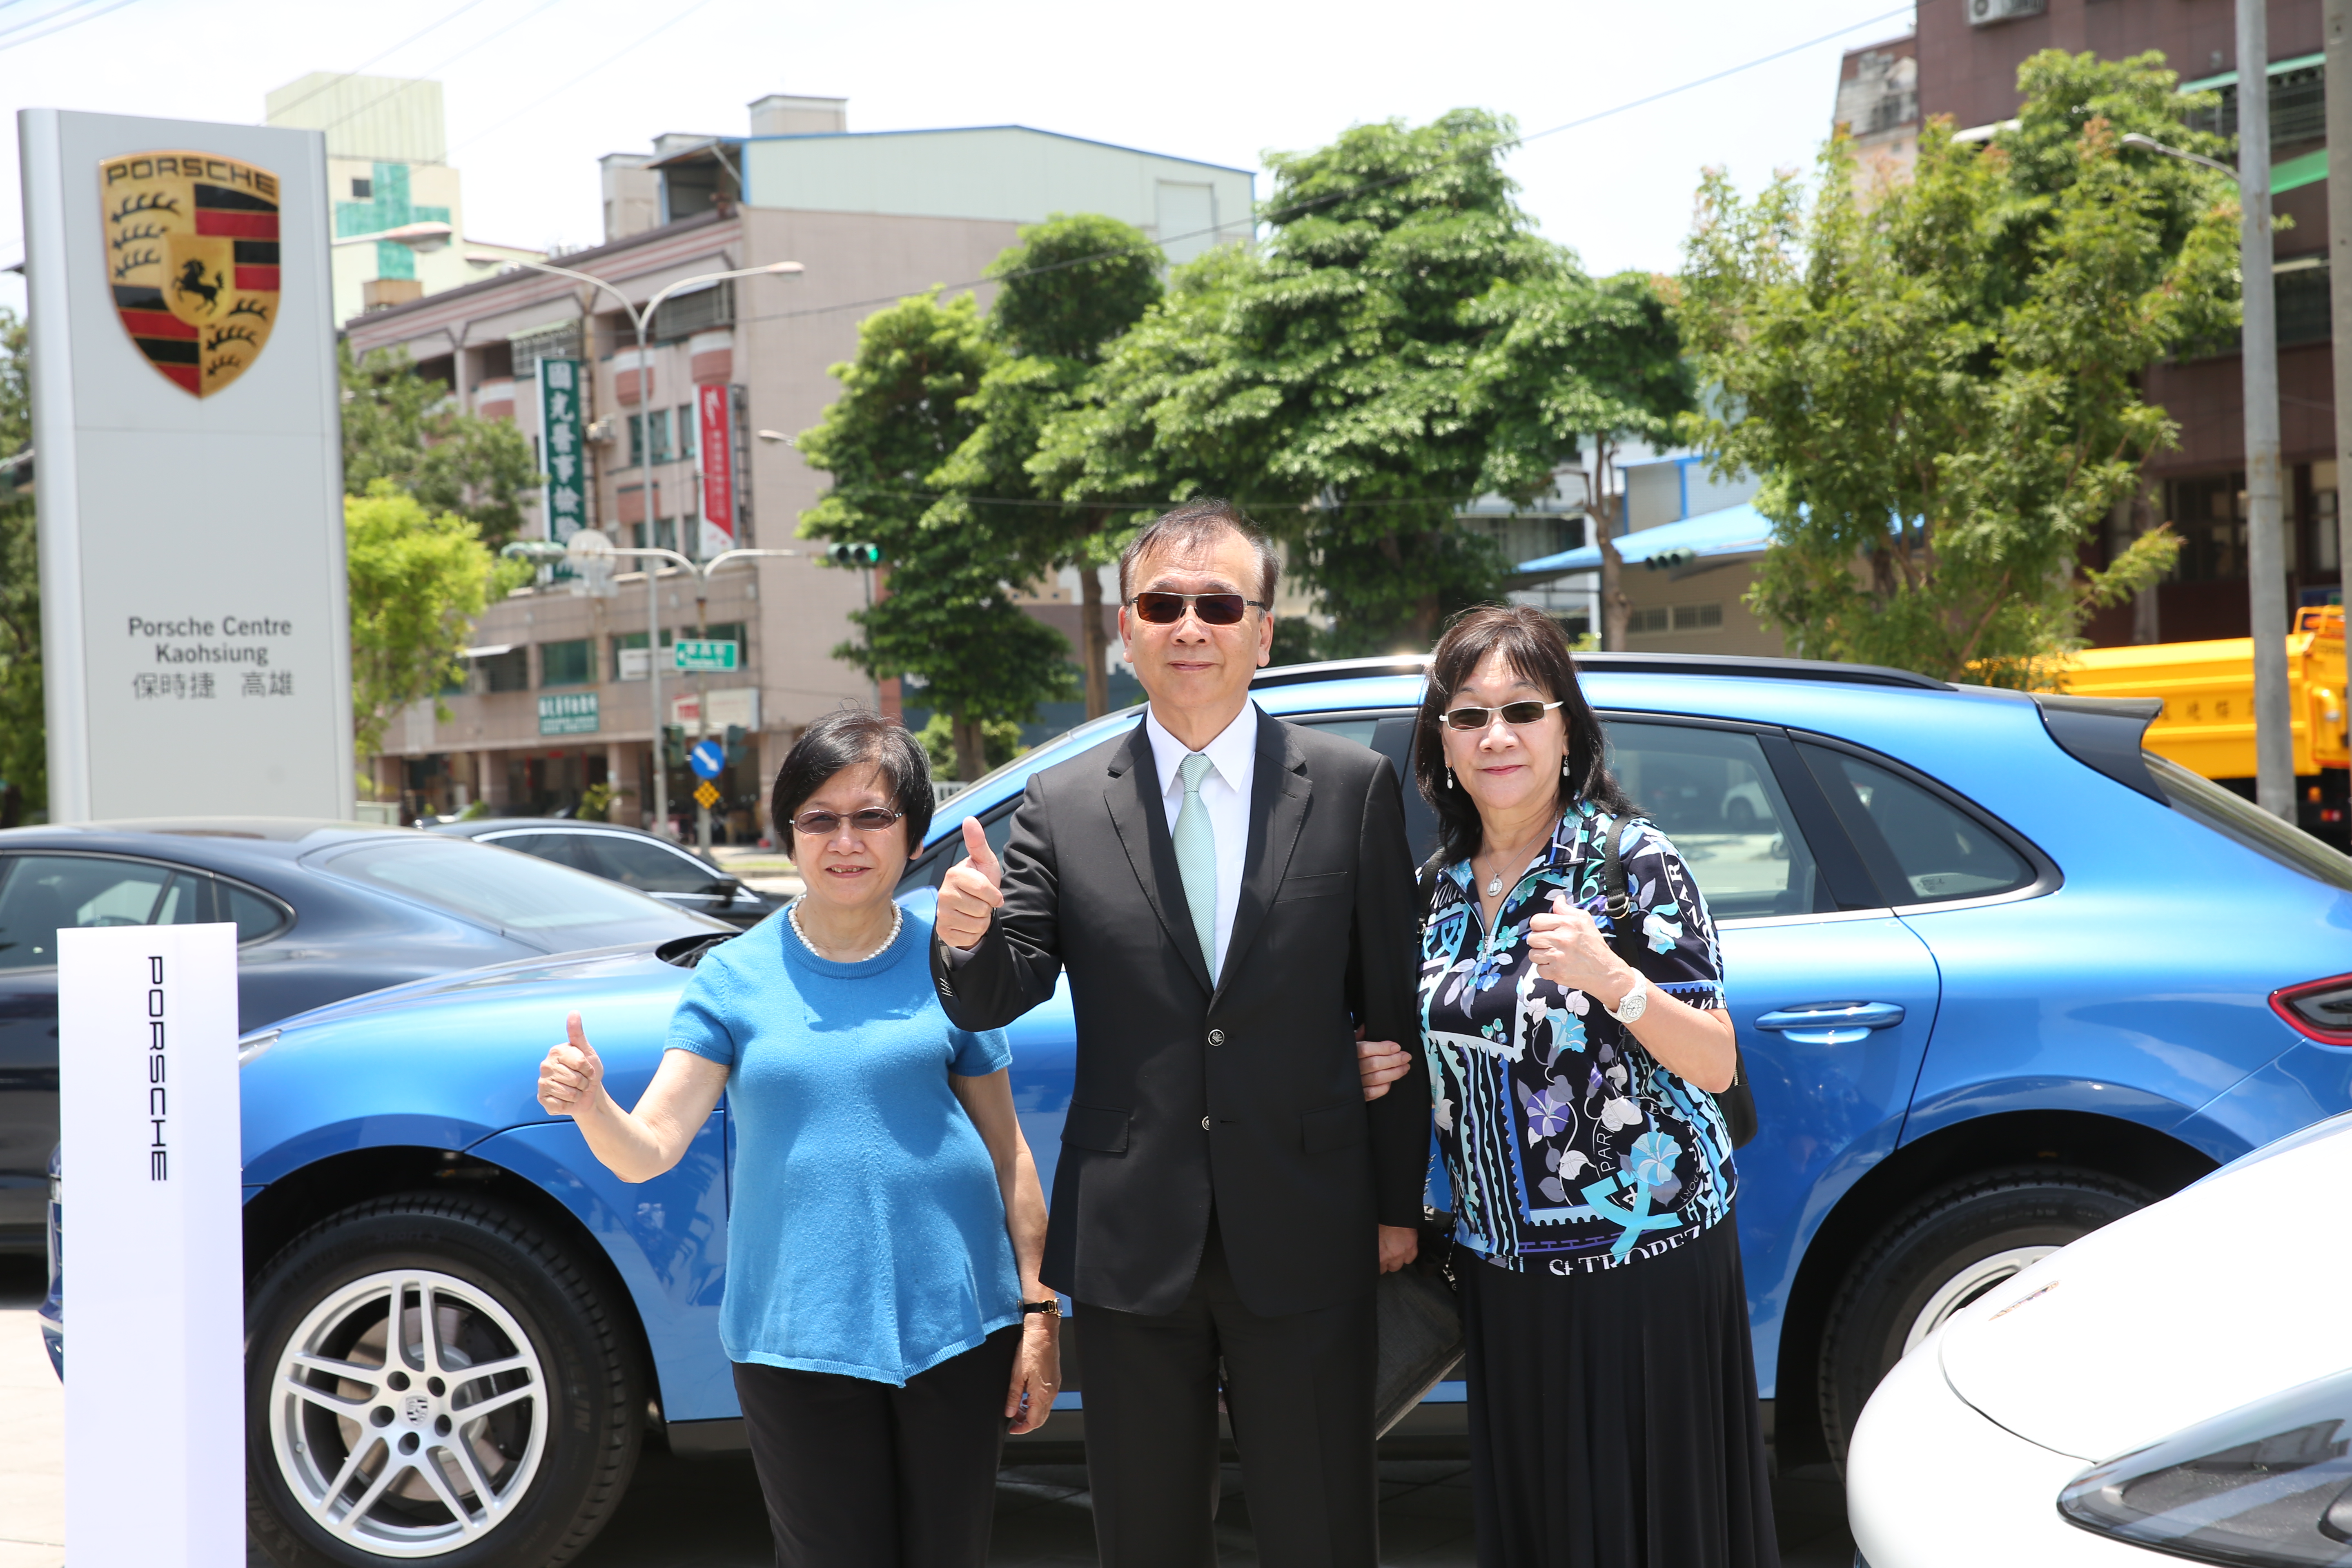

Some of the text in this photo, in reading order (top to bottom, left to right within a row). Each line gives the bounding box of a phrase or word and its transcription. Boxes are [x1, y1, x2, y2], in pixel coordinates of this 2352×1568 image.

[107, 157, 275, 197] PORSCHE
[128, 615, 292, 637] Porsche Centre
[156, 643, 269, 666] Kaohsiung
[131, 670, 295, 699] 保時捷 高雄
[148, 956, 167, 1181] PORSCHE
